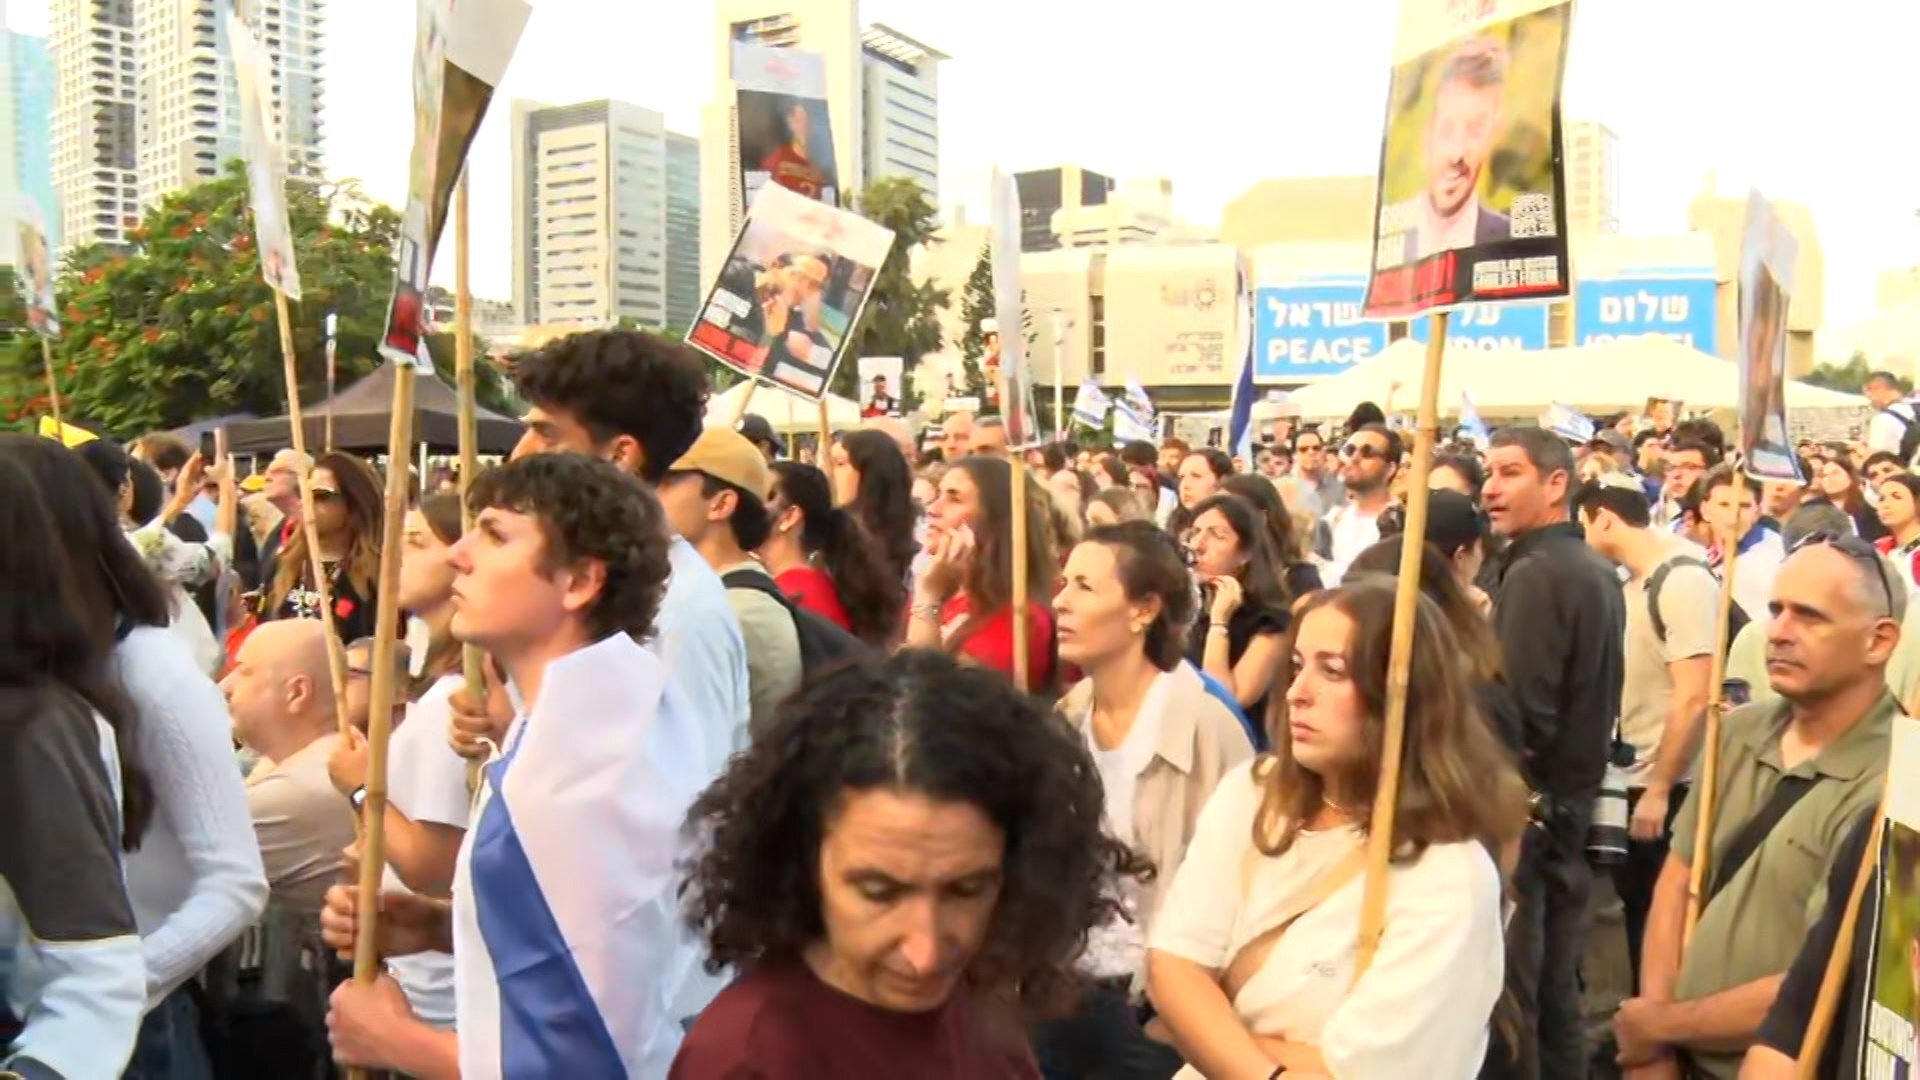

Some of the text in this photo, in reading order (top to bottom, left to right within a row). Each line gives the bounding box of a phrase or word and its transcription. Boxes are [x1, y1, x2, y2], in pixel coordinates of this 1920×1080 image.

[1267, 297, 1357, 328] שראל
[1599, 289, 1690, 323] שלום
[1268, 338, 1371, 365] PEACE
